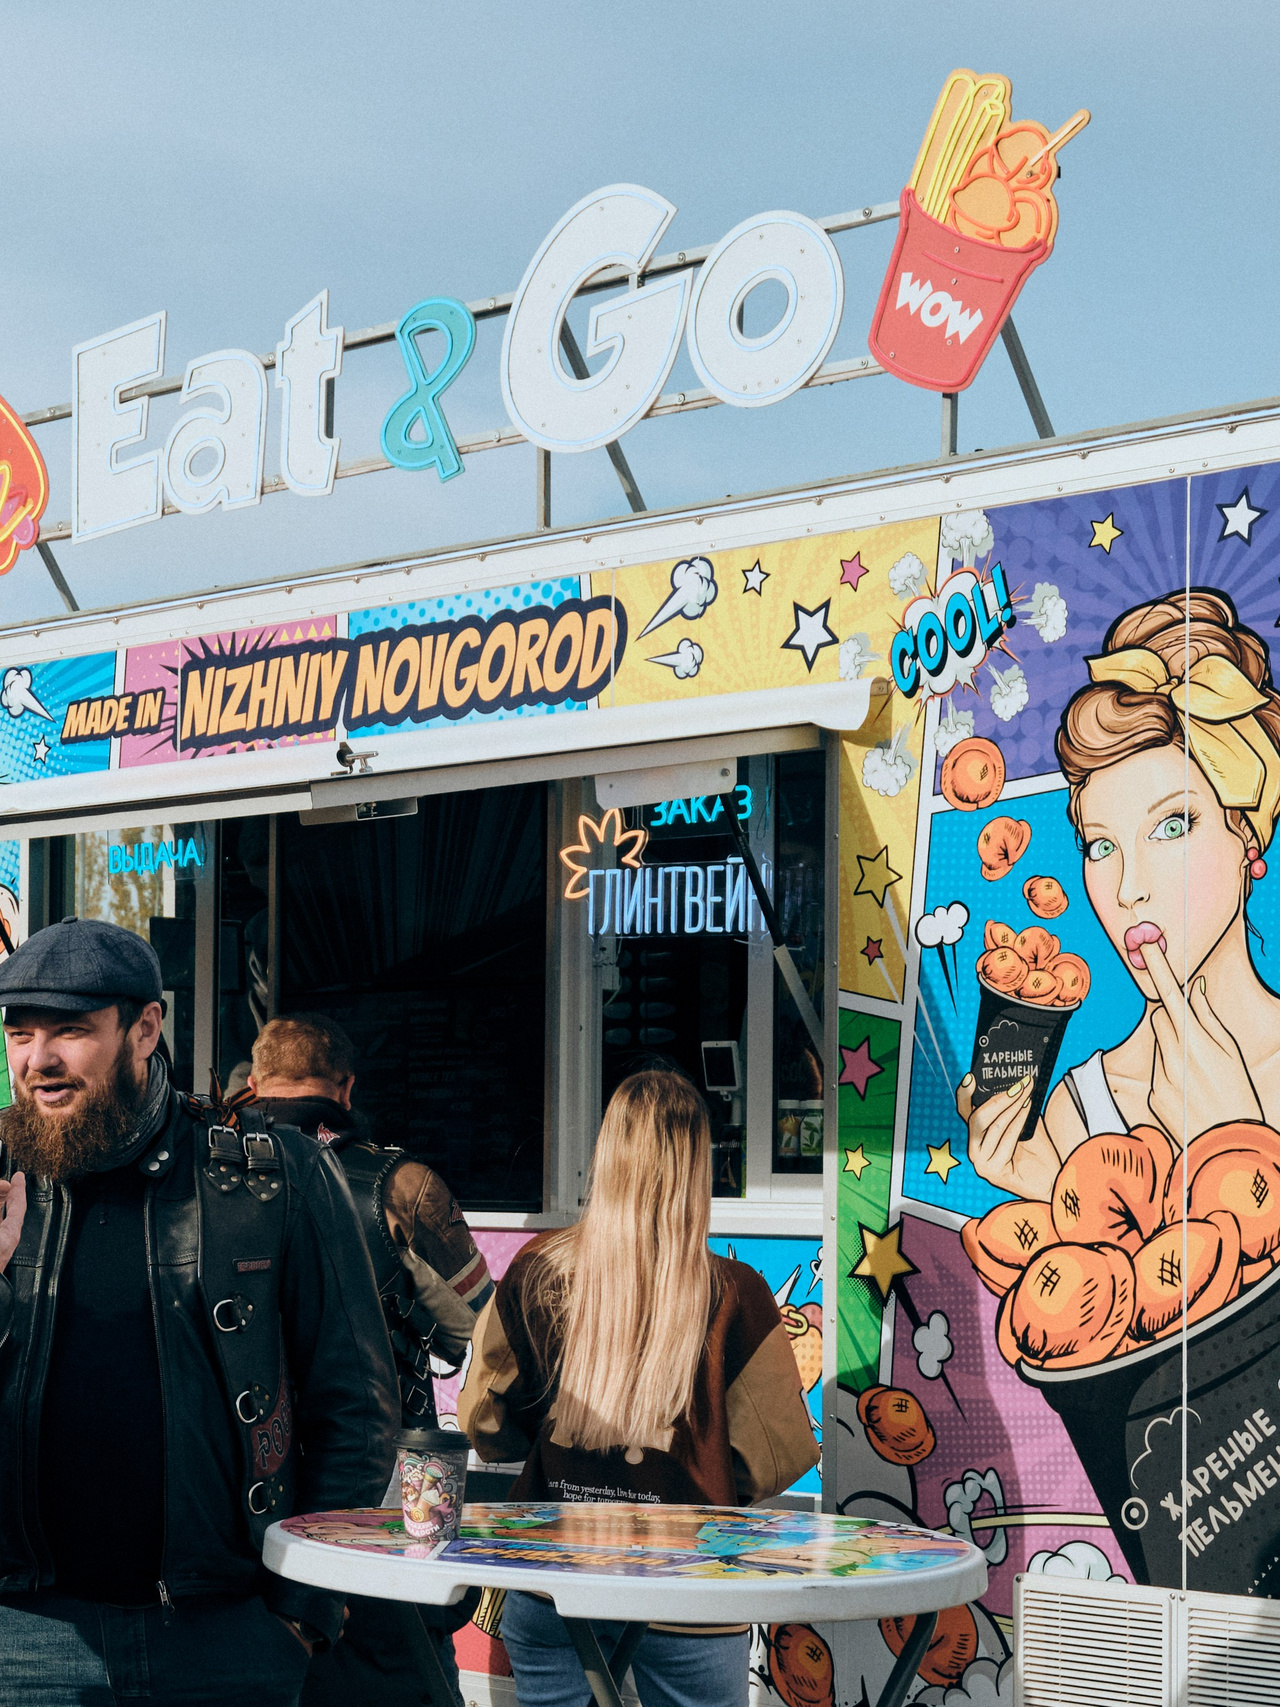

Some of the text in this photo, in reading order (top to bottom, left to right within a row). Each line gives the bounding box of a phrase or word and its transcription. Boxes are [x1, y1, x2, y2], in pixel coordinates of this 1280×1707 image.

[896, 272, 983, 345] WOW
[71, 183, 846, 545] Eat & Go
[891, 562, 1015, 696] COOL!
[62, 607, 618, 741] MADE IN NIZHNIY NOVGOROD
[108, 837, 201, 875] ВЫДАЧА
[588, 857, 769, 935] ГЛИНТВЕЙН
[982, 1065, 1038, 1080] ПЕЛЬМЕНИ
[560, 1479, 580, 1491] from
[580, 1486, 616, 1498] yesterday,
[563, 1489, 582, 1502] hope
[1160, 1408, 1277, 1521] ЖАРЕНЫЕ
